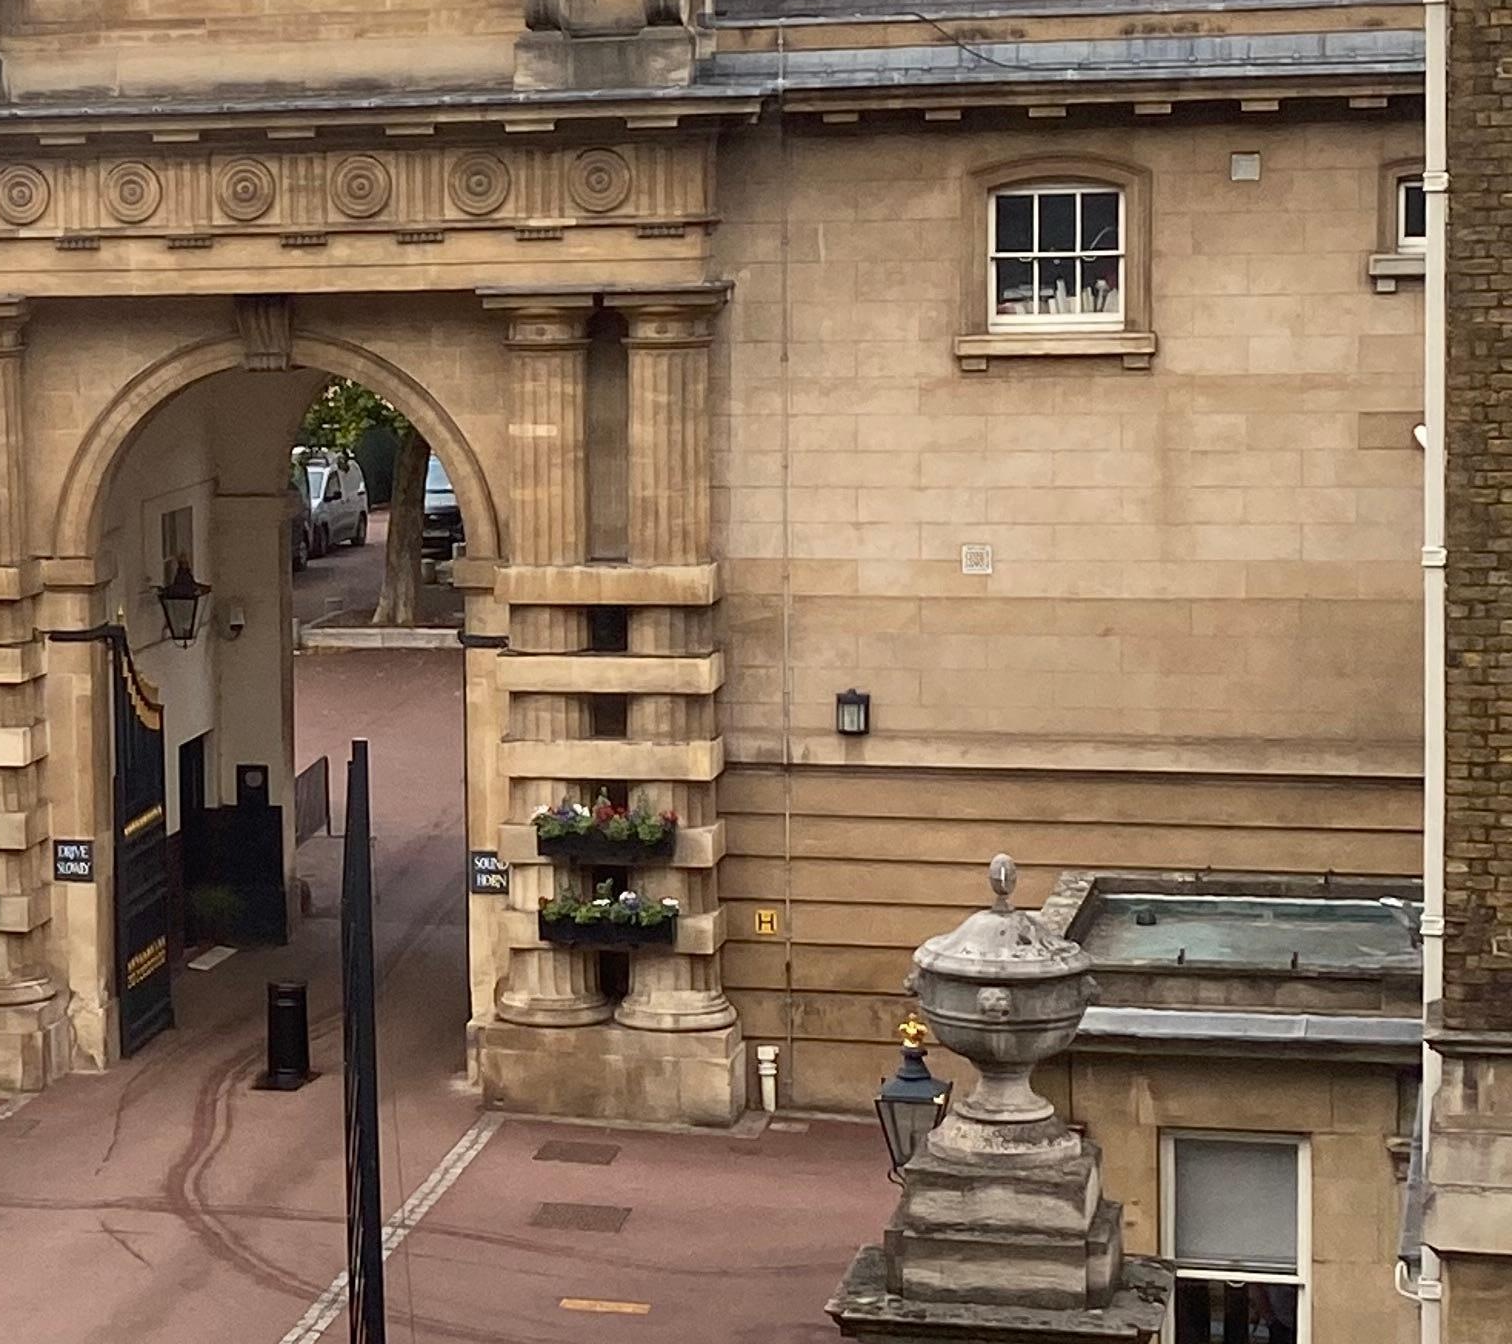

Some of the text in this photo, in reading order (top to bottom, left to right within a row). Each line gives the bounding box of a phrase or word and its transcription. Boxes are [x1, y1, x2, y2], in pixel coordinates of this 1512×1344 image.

[57, 845, 89, 860] DRIVE
[474, 856, 509, 870] SOUND
[476, 873, 507, 888] HORN
[758, 912, 774, 931] H
